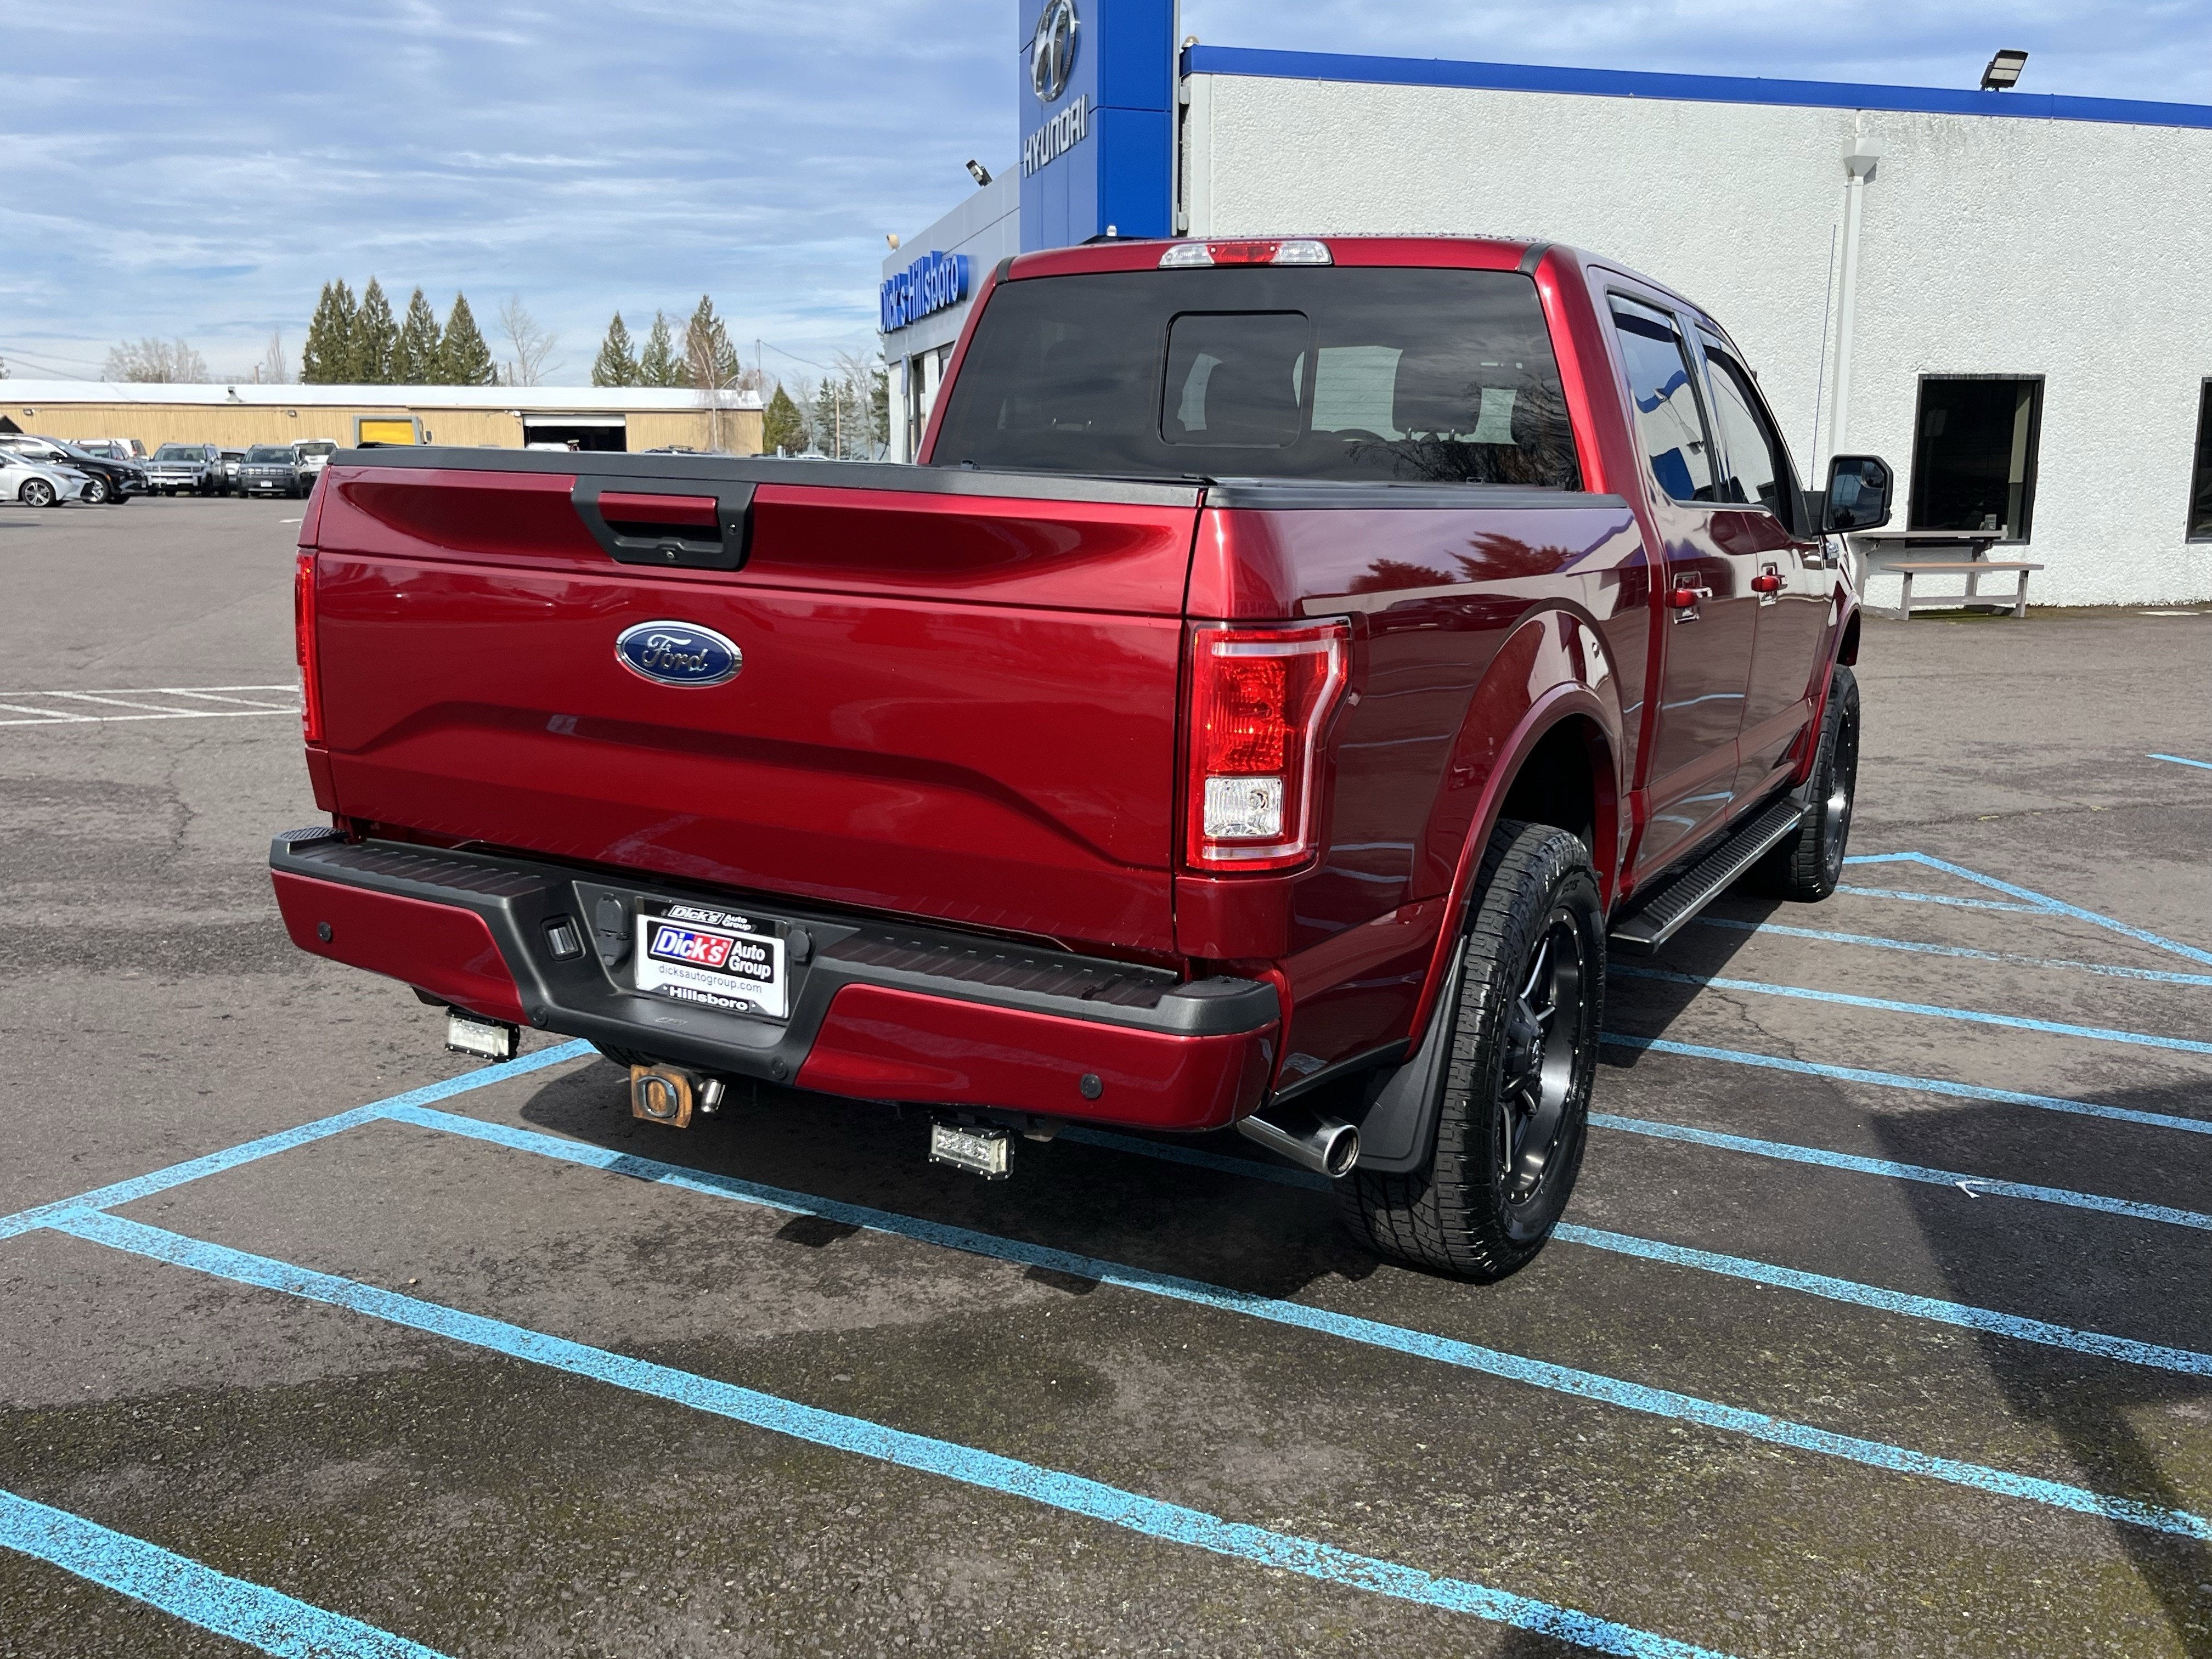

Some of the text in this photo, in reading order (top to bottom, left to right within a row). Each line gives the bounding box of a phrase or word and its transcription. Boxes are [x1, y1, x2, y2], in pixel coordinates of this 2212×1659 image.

[1024, 94, 1088, 178] HYUNDAI
[879, 251, 961, 334] Dick's Hillsboro
[641, 634, 709, 672] Ford
[670, 906, 748, 924] Dick's Auto
[722, 918, 752, 932] Group
[656, 930, 766, 963] Dick's Auto
[658, 964, 763, 994] dicksautogroup.com
[729, 955, 771, 980] Group
[669, 986, 748, 1011] Hillsboro
